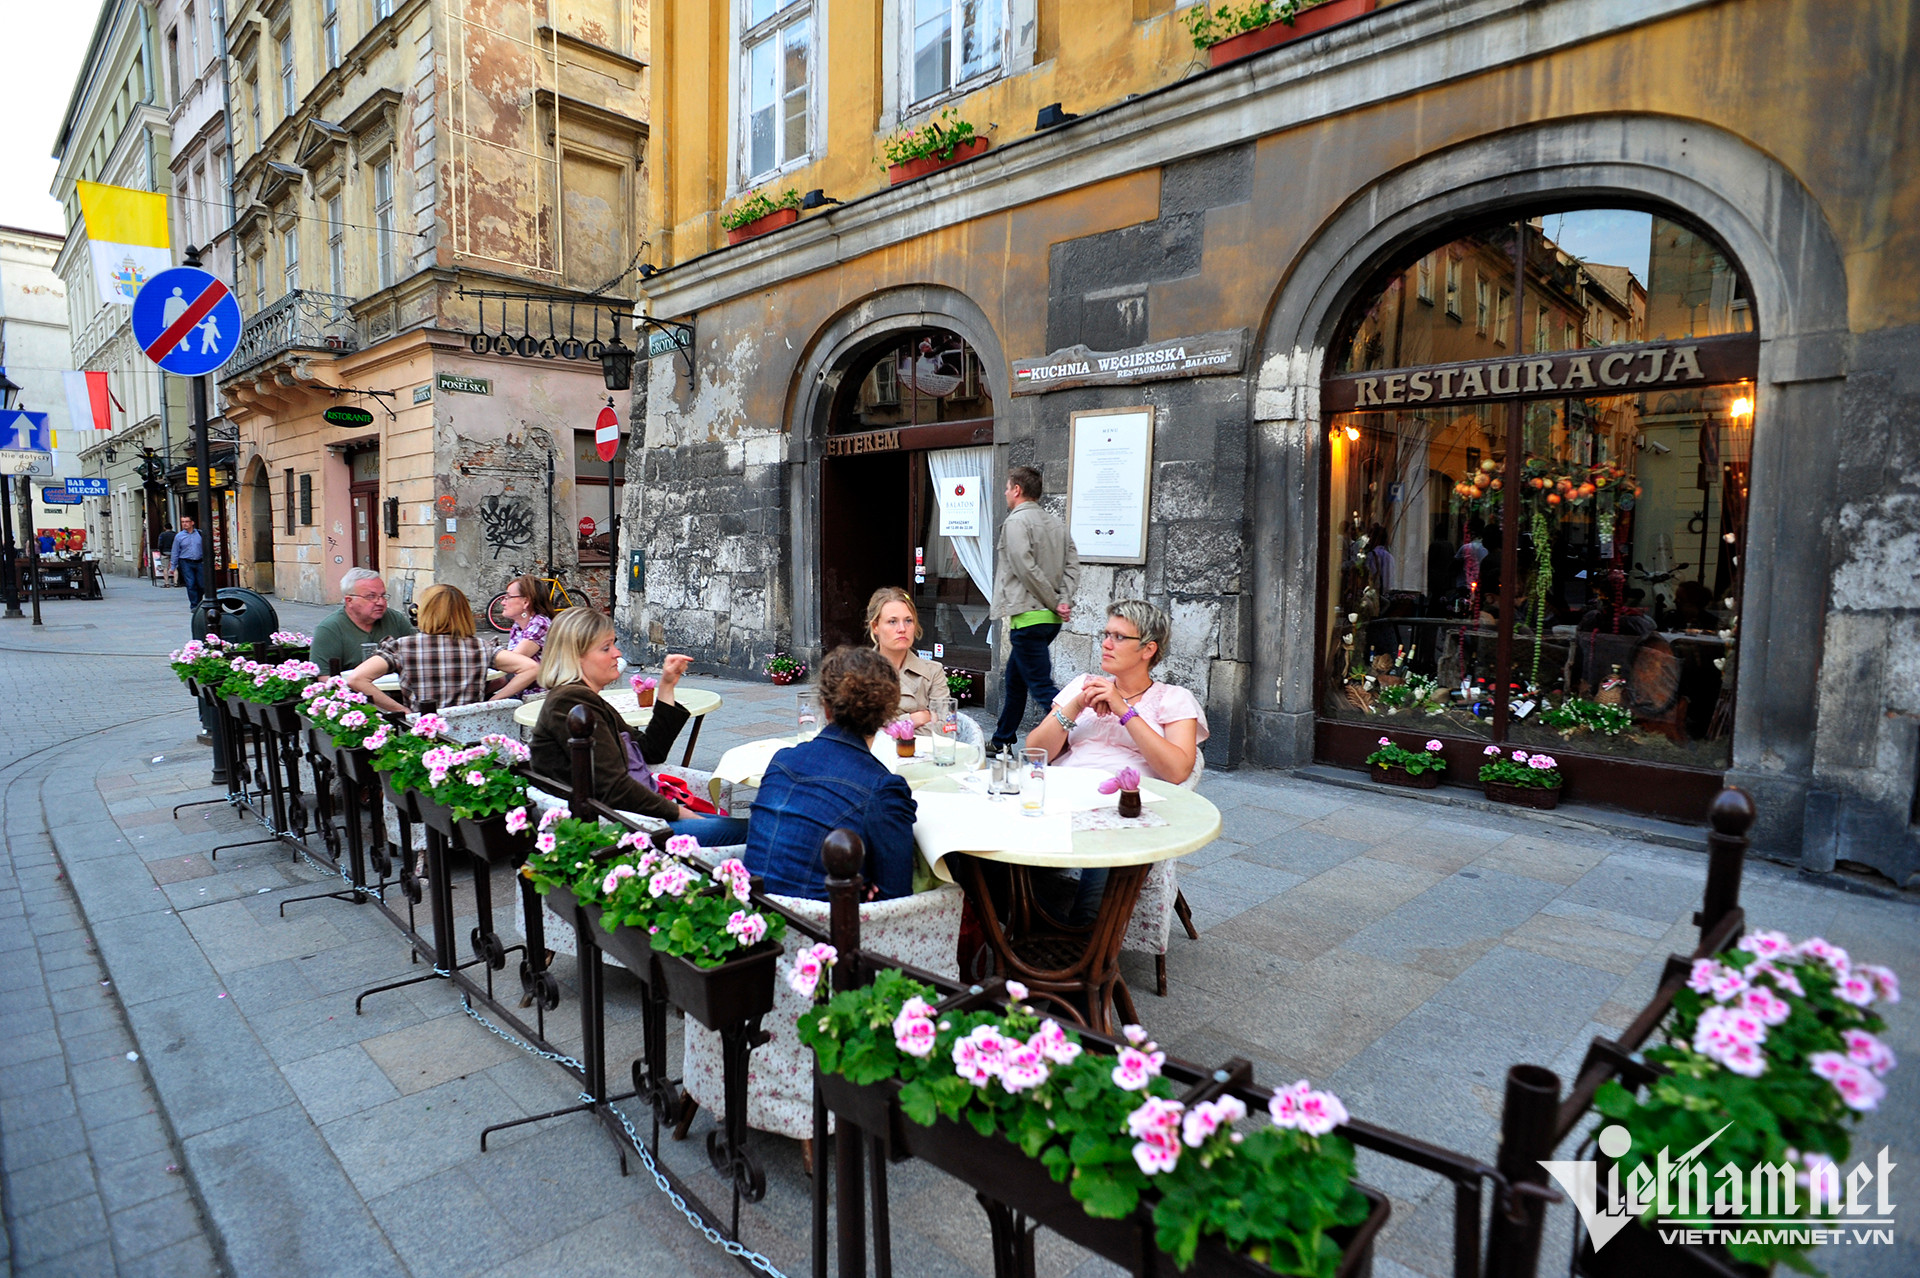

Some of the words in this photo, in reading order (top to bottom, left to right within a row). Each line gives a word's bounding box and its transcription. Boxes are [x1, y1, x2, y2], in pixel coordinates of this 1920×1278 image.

[477, 335, 627, 362] BALATO
[1031, 362, 1090, 380] KUCHNIA
[1097, 346, 1186, 373] WĘGIERSKA
[1116, 363, 1176, 378] RESTAURACJA
[441, 380, 487, 393] POSELSKA
[1354, 346, 1705, 407] RESTAURACJA
[327, 412, 372, 423] RISTORANTE
[826, 430, 900, 455] ETTEREM
[19, 453, 50, 461] dotyczy
